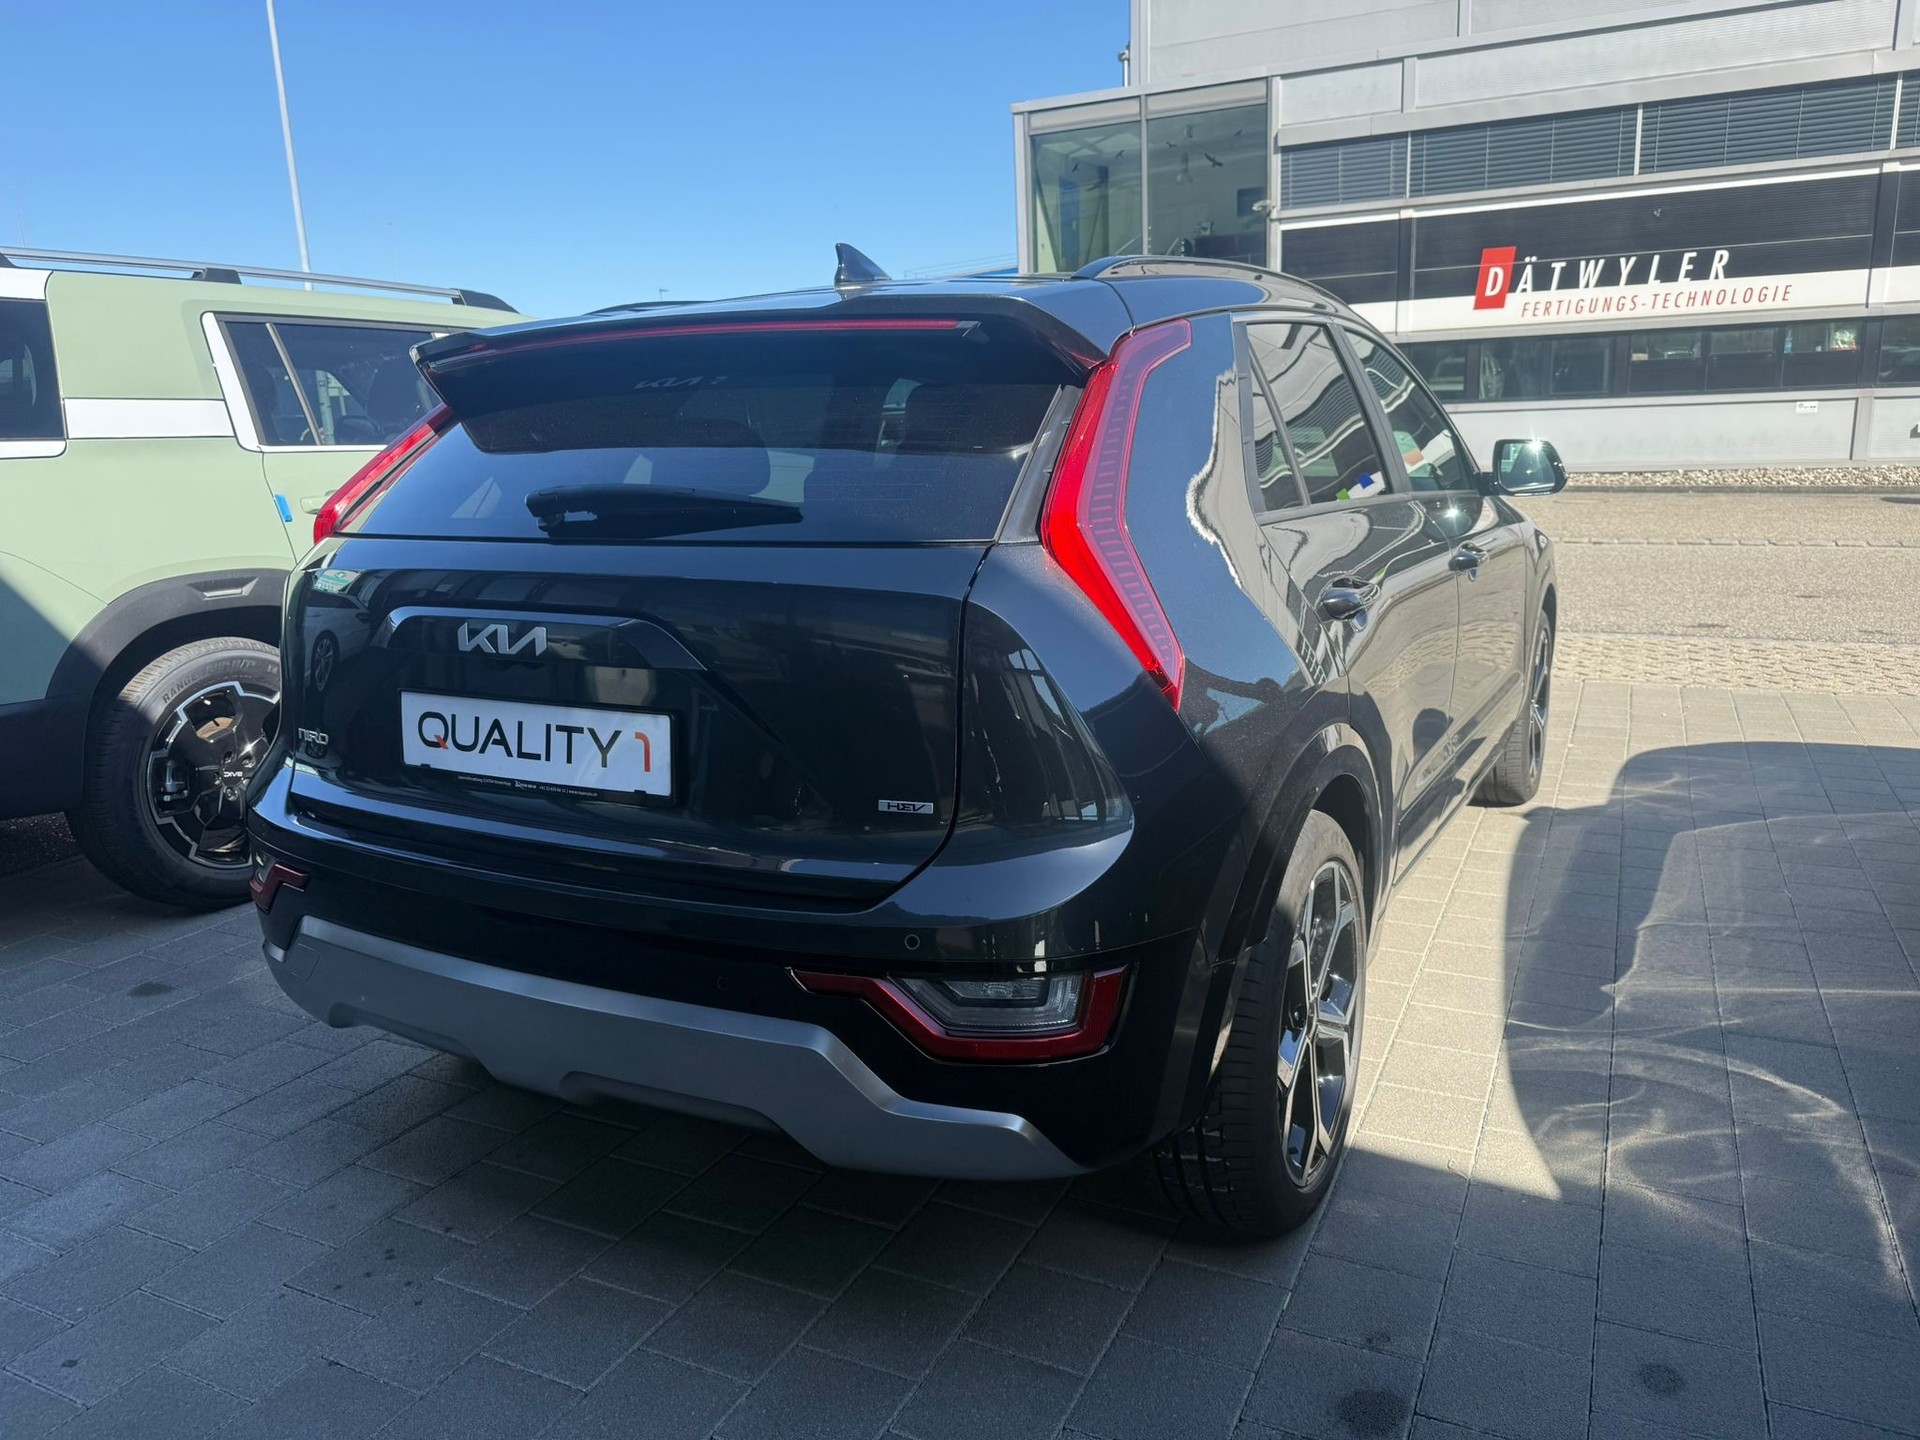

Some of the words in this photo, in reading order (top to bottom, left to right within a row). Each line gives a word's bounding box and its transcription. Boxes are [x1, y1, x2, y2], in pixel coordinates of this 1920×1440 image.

[1484, 249, 1730, 298] DÄTWYLER
[1521, 284, 1793, 318] FERTIGUNGS-TECHNOLOGIE
[457, 622, 547, 656] KIA
[298, 727, 329, 745] NIRO
[418, 711, 622, 768] QUALITY
[634, 731, 651, 773] 1
[887, 801, 926, 812] HEV
